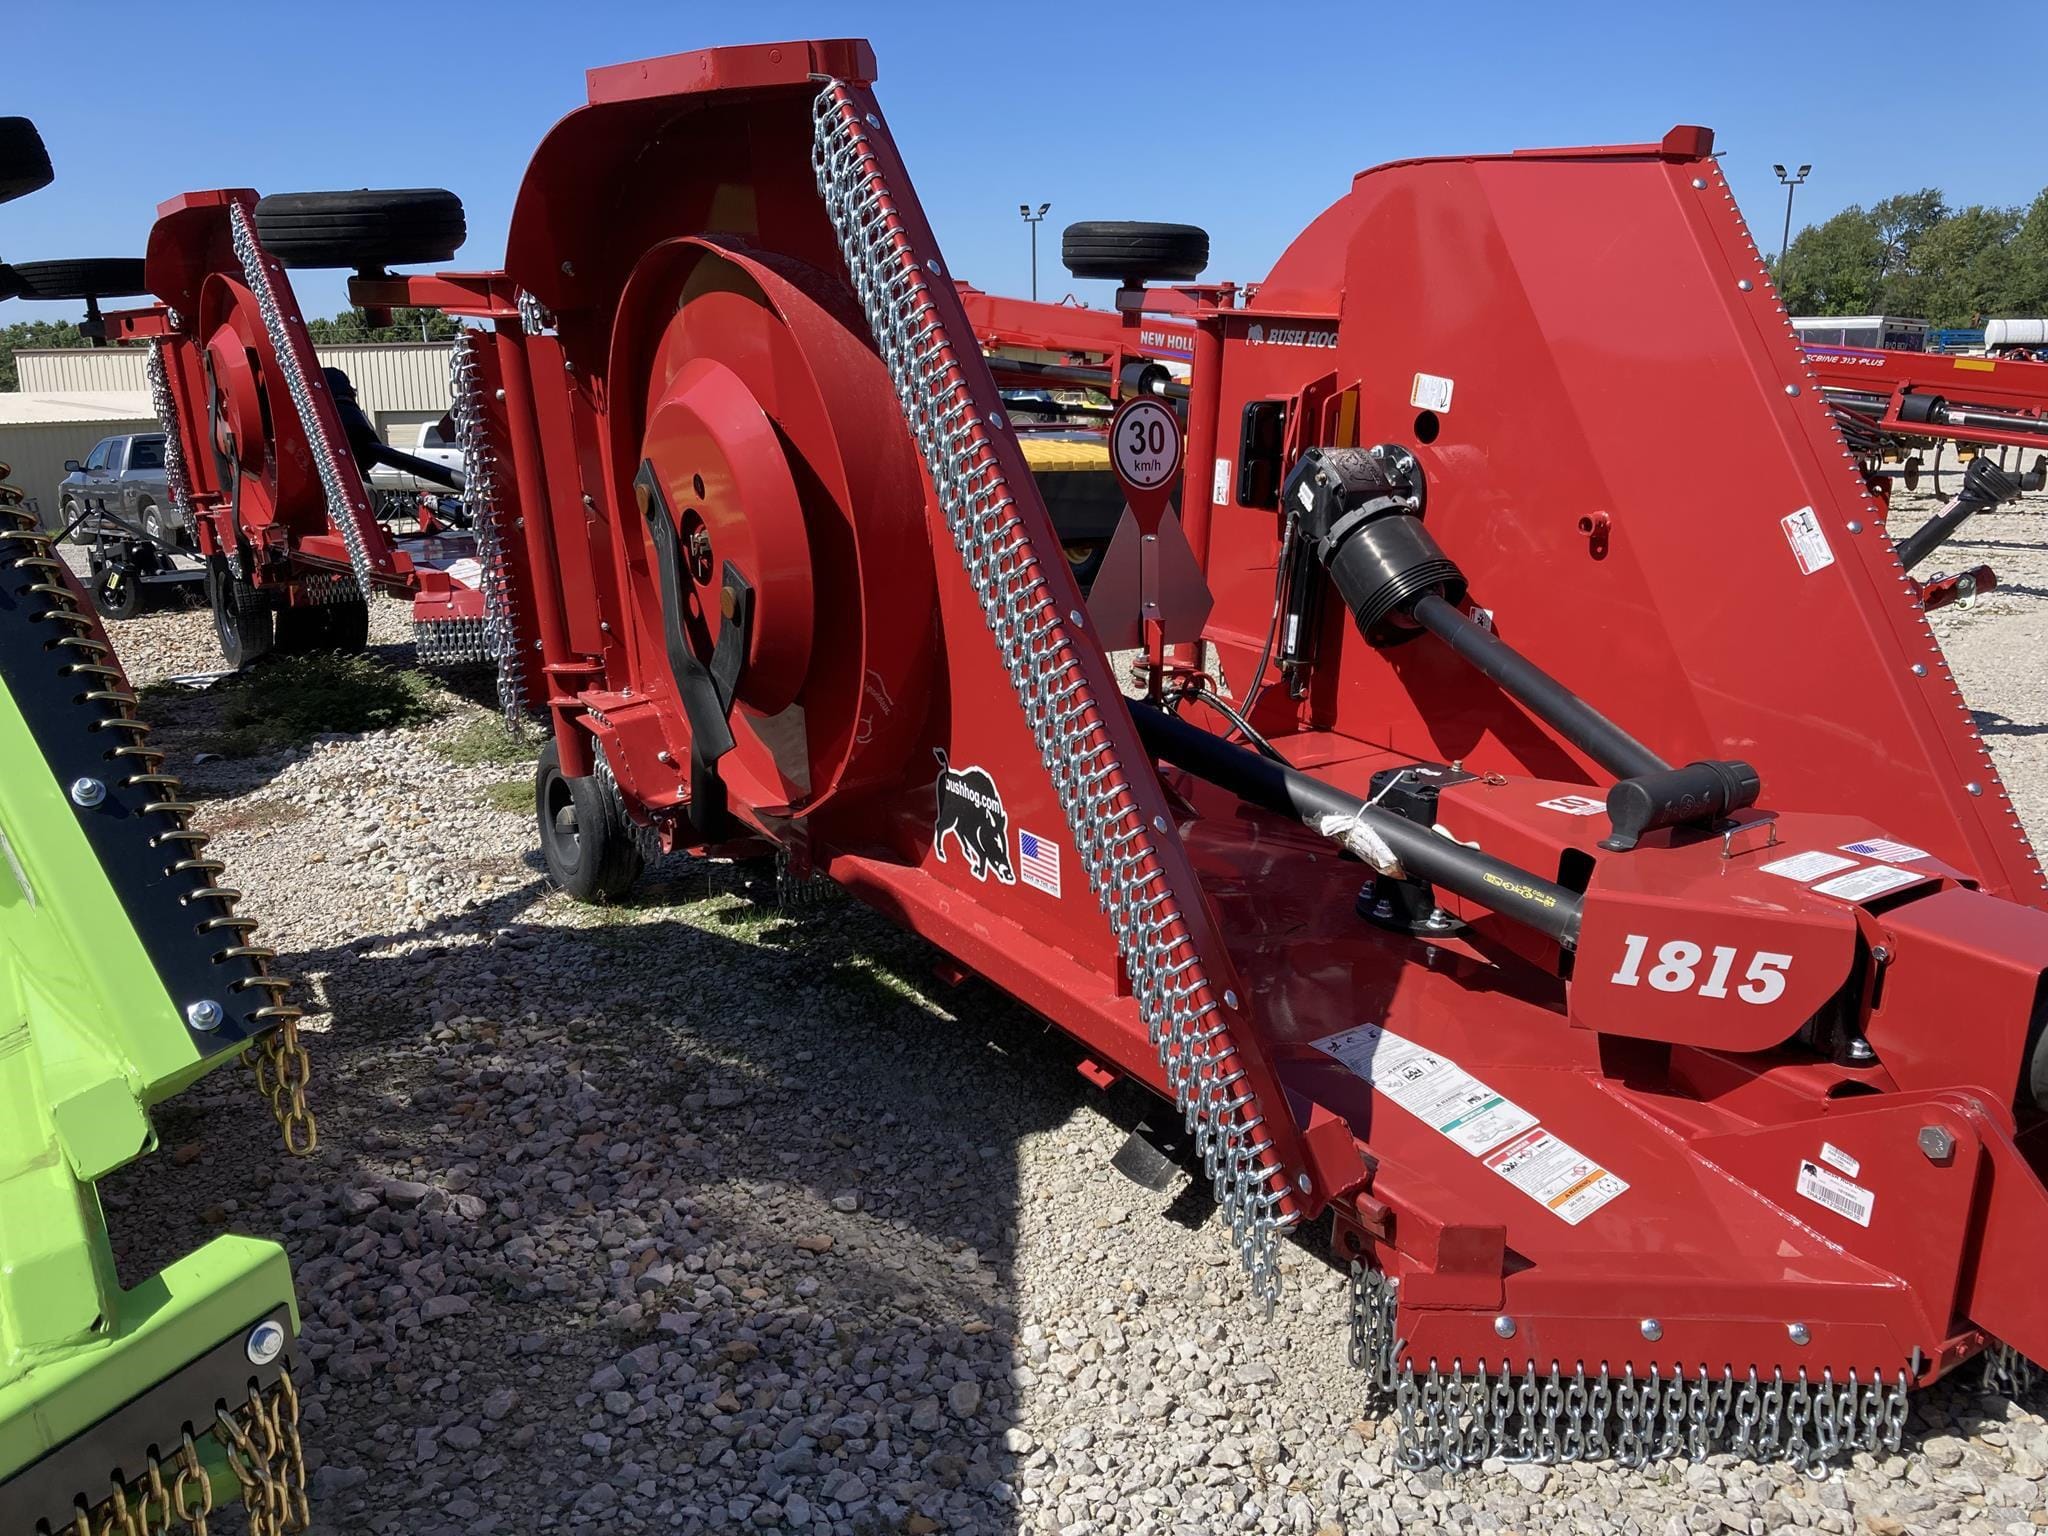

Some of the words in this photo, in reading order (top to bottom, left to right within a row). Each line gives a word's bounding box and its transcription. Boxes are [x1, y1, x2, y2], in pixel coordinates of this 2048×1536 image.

[1140, 330, 1164, 346] NEW
[1267, 328, 1306, 345] BUSH
[1840, 356, 1856, 365] 313
[1859, 357, 1886, 367] PLUS
[1129, 420, 1165, 455] 30
[1134, 459, 1161, 472] km/h
[1610, 934, 1793, 1005] 1815
